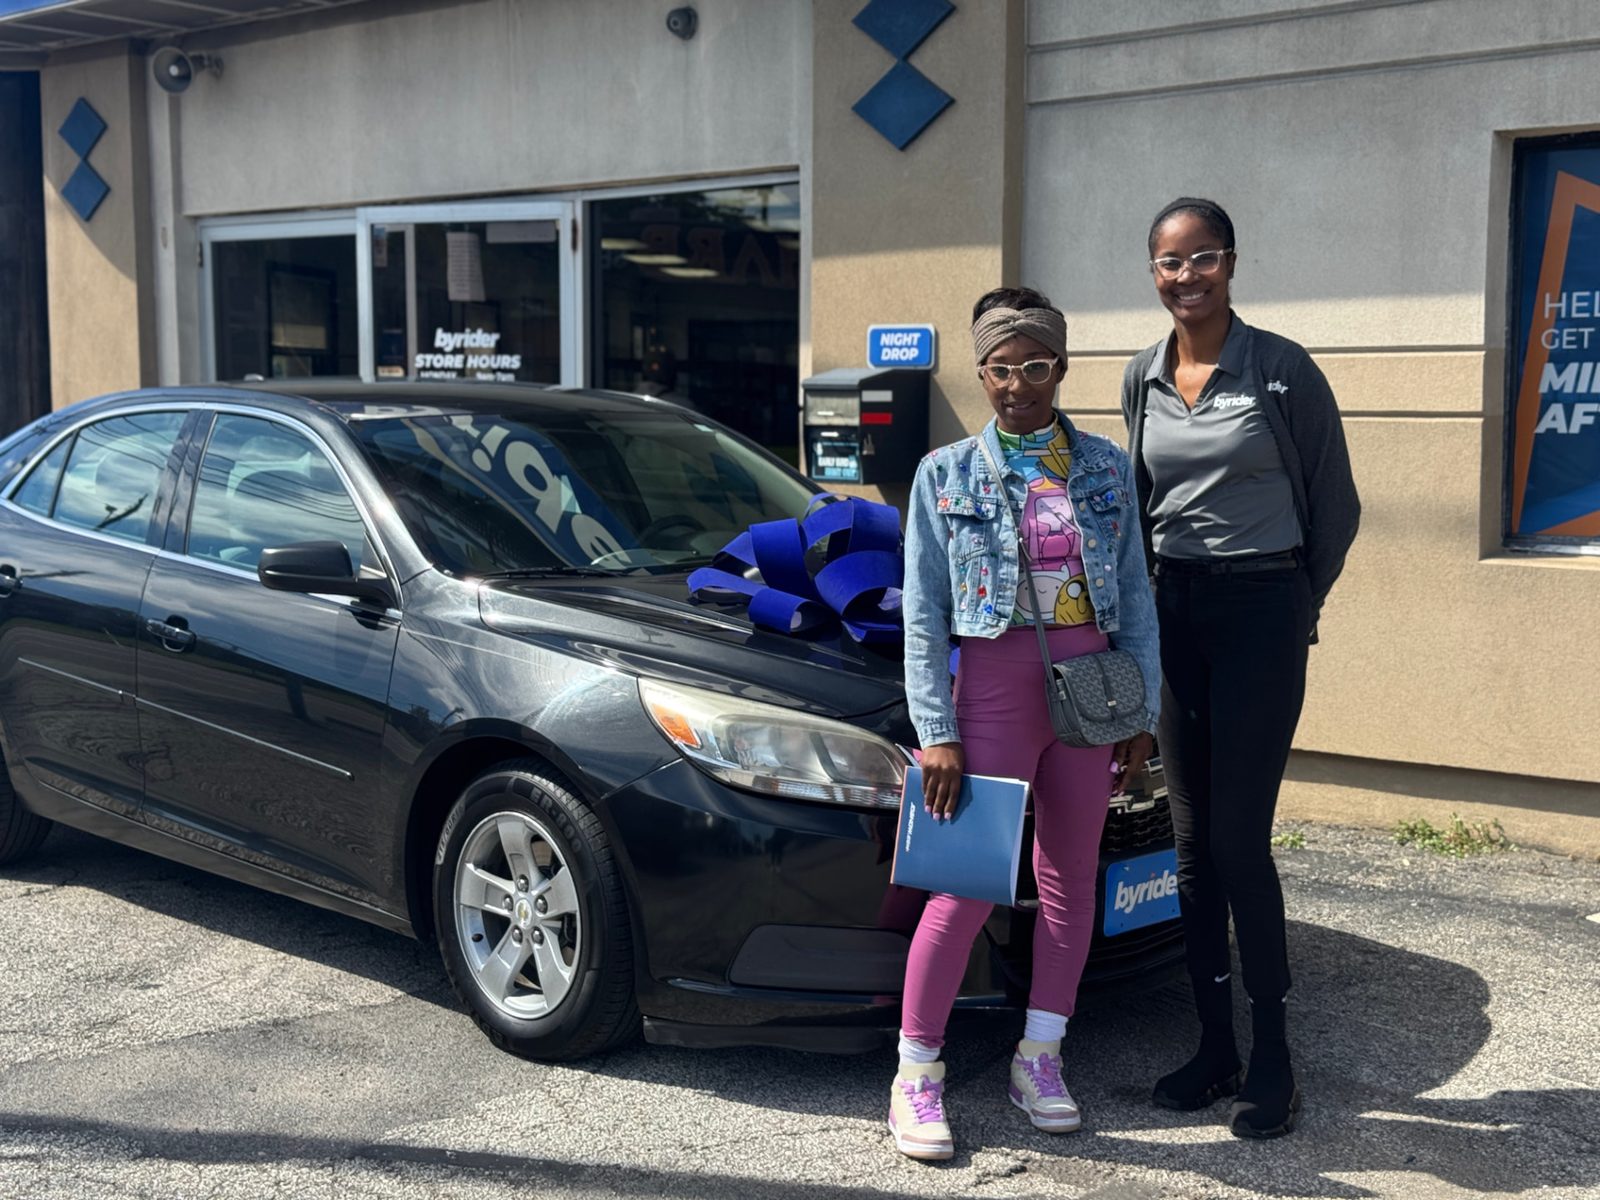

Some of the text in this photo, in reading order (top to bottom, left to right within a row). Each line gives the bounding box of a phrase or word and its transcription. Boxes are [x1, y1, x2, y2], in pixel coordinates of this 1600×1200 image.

[434, 327, 500, 352] byrider
[880, 332, 921, 346] NIGHT
[1541, 328, 1595, 349] GET
[414, 354, 521, 369] STORE HOURS
[880, 347, 919, 361] DROP
[1533, 402, 1600, 434] AF
[1114, 869, 1178, 914] byride
